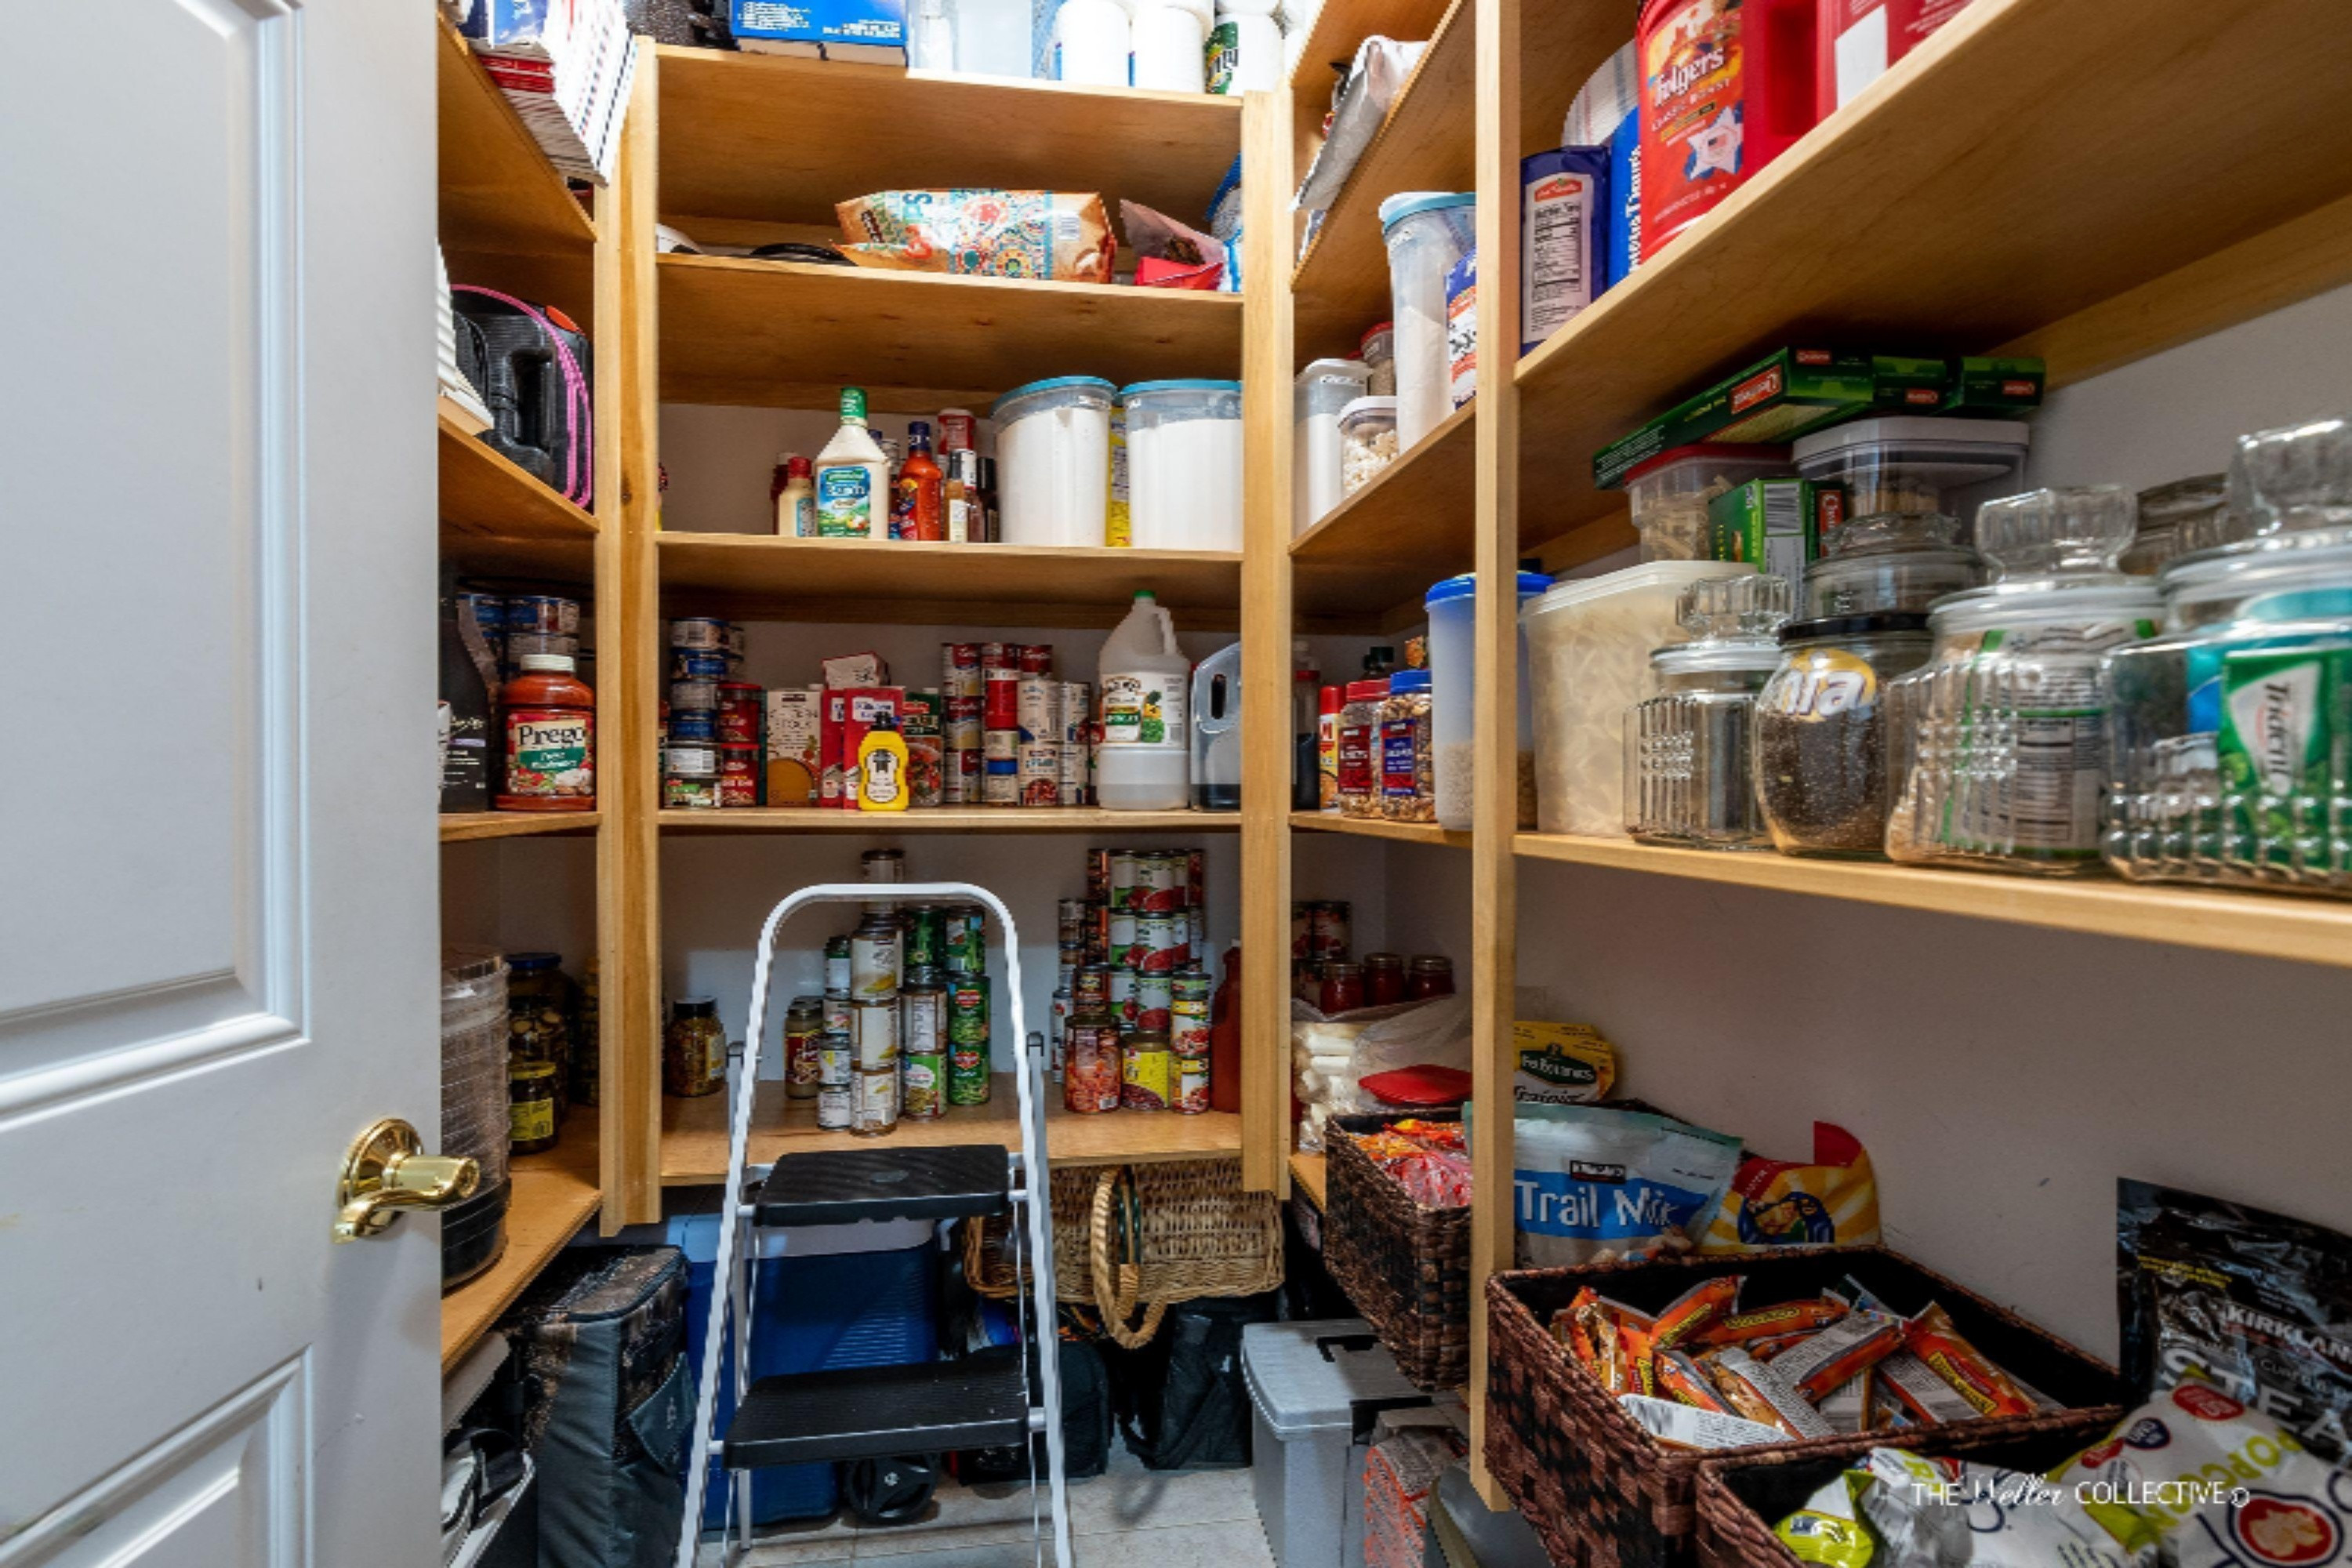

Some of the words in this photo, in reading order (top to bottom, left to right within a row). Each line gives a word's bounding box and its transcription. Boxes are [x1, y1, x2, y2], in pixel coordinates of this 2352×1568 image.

[1651, 100, 1688, 132] CLASSIC
[1689, 77, 1731, 105] ROAST
[1653, 47, 1725, 108] Folgers
[517, 724, 586, 749] Prego
[2263, 680, 2292, 775] Trident
[1515, 1178, 1601, 1229] Trail
